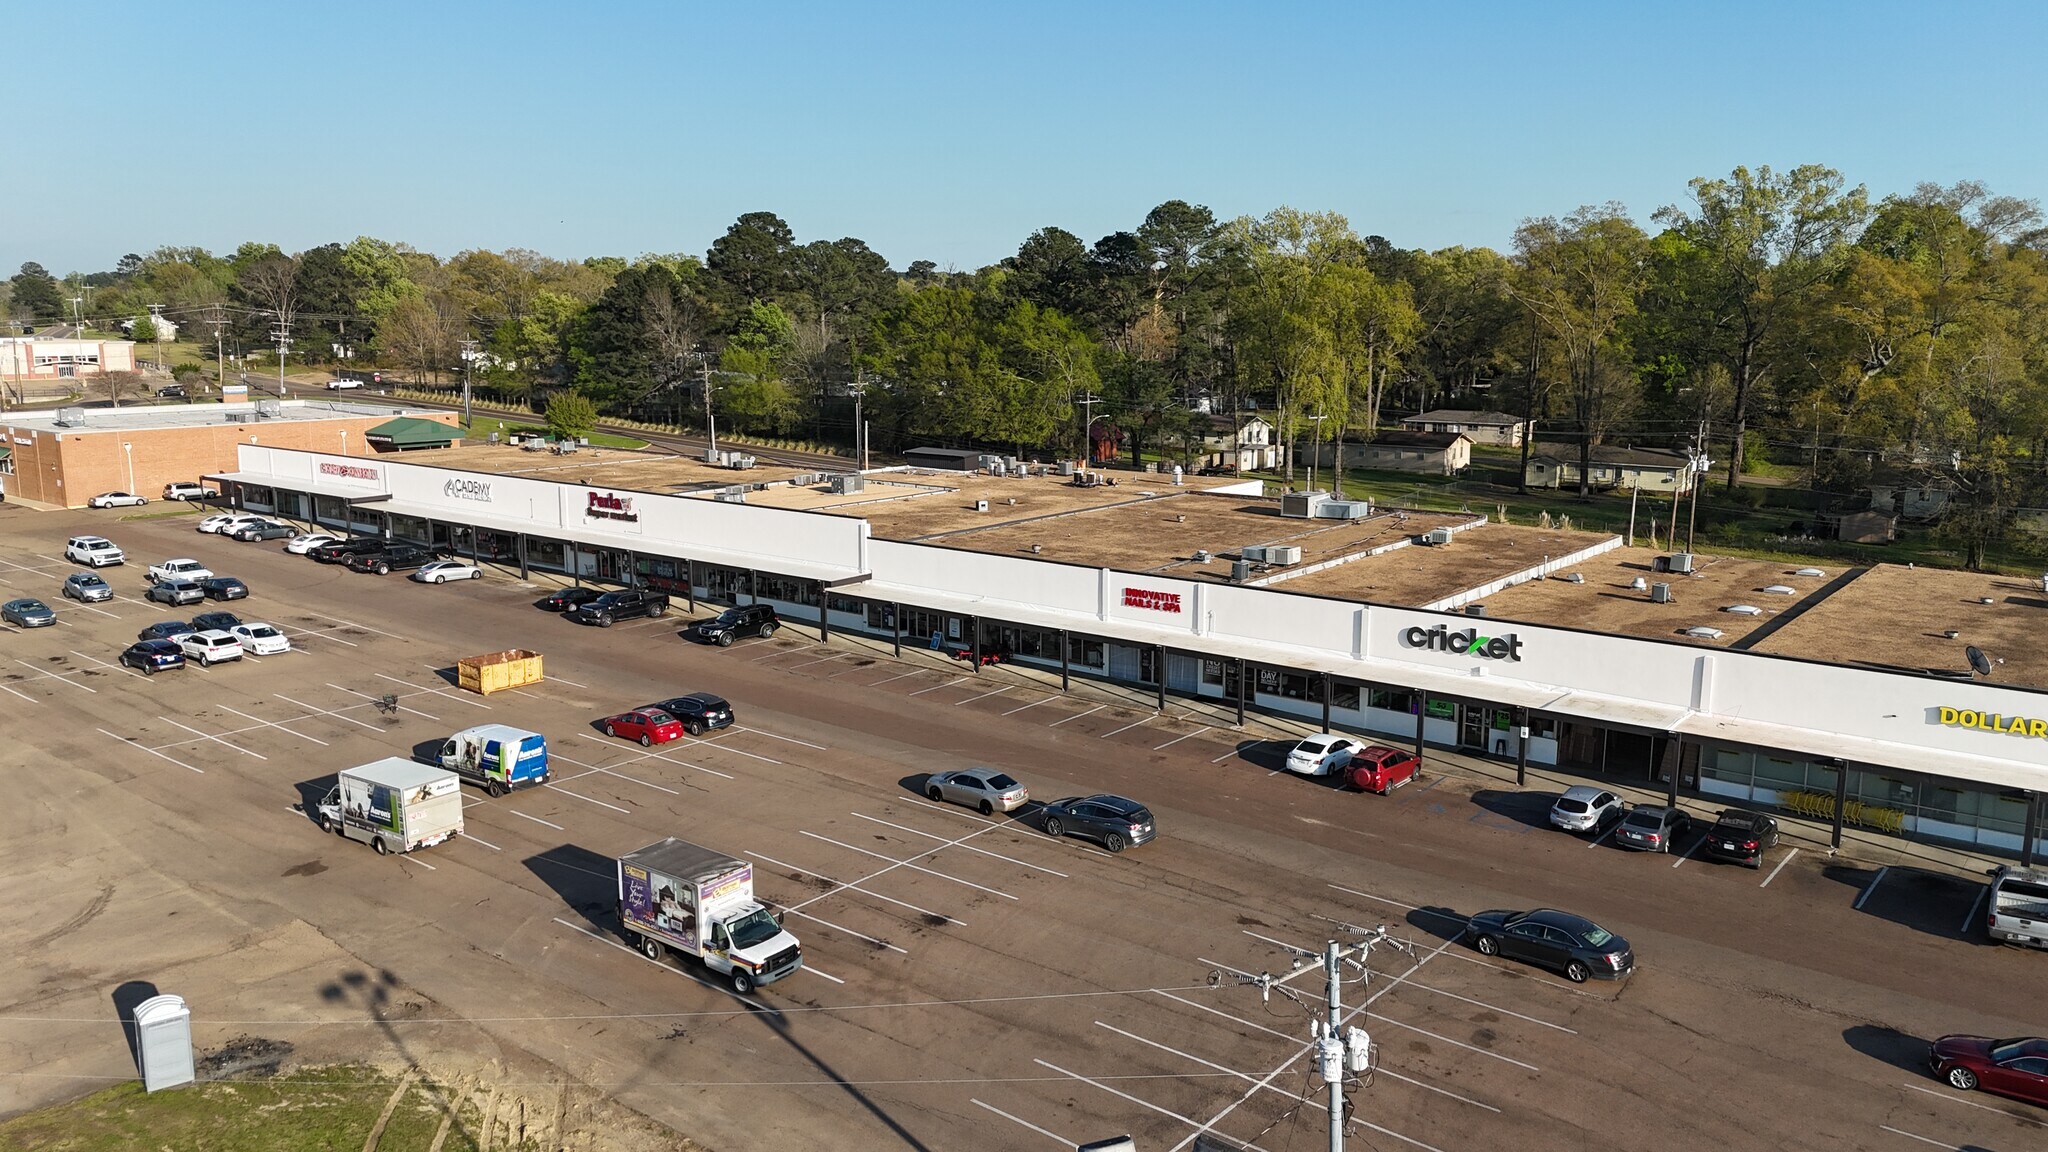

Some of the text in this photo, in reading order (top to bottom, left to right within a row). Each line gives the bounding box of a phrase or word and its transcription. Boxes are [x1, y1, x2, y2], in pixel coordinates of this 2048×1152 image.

[1125, 587, 1181, 603] INNOVATIVE
[1124, 597, 1181, 613] NAILS & SPA
[1406, 624, 1523, 662] cricket
[1261, 671, 1277, 681] DAY
[1939, 706, 2048, 738] DOLLAR
